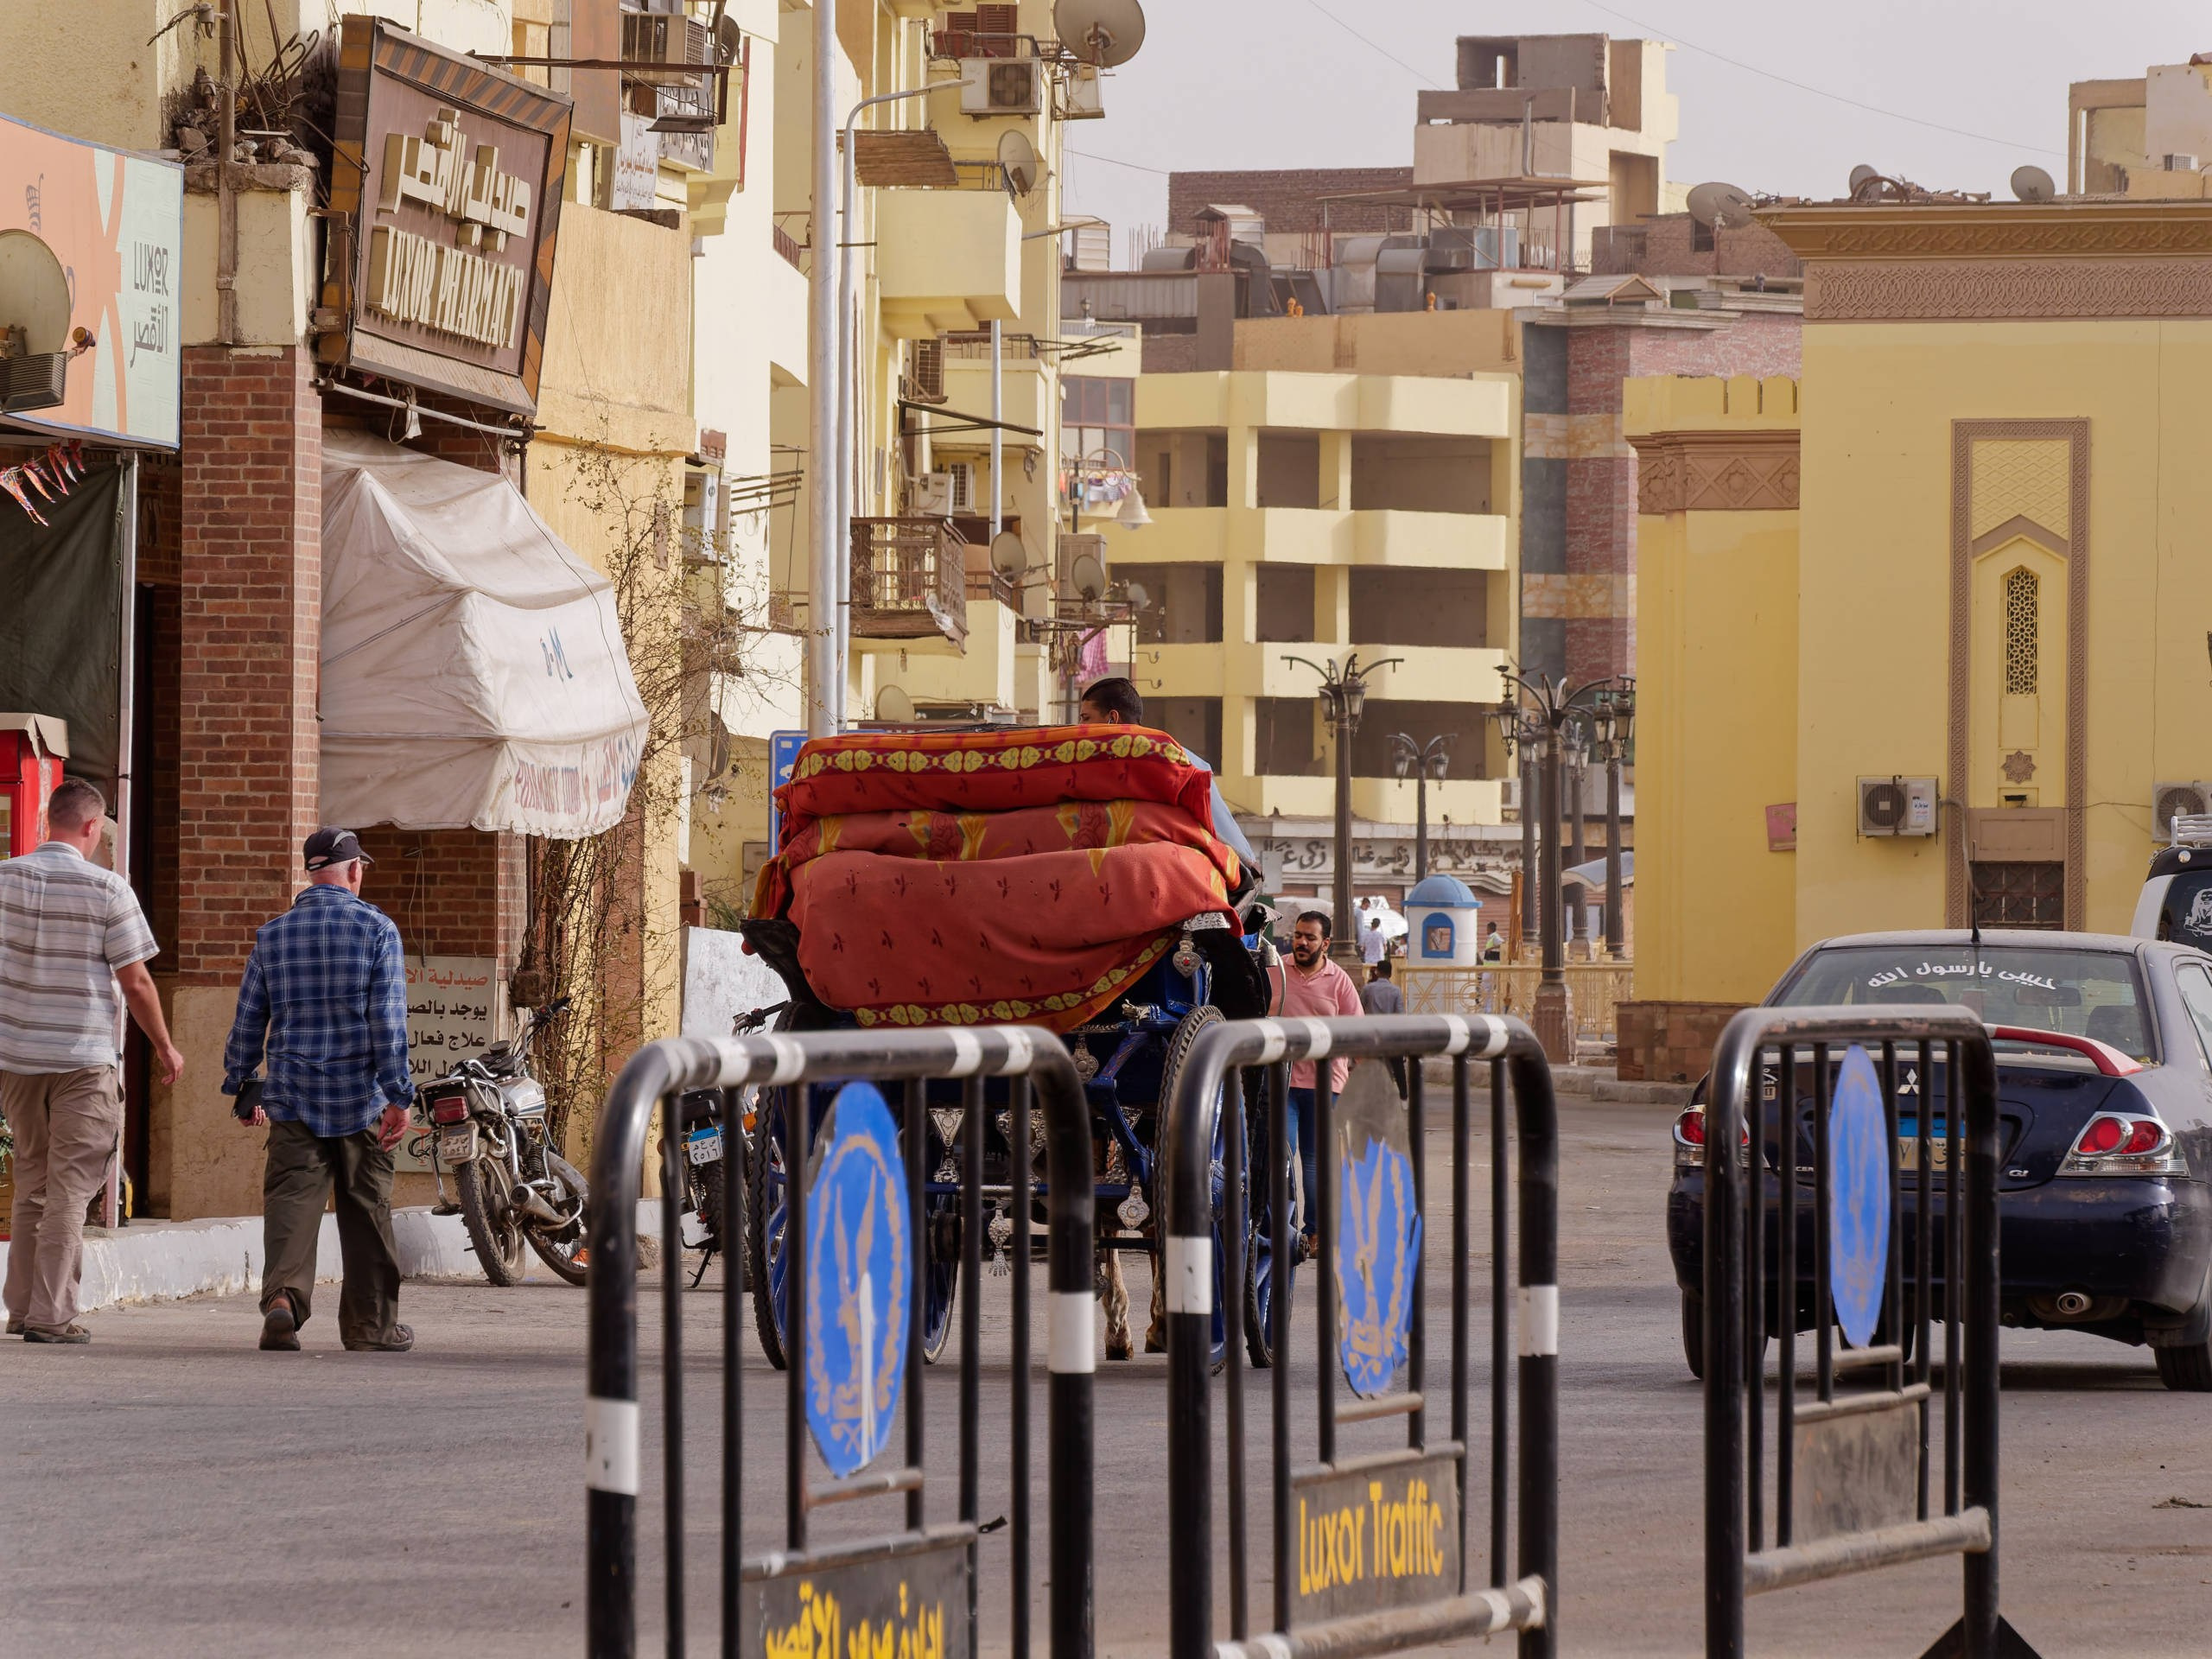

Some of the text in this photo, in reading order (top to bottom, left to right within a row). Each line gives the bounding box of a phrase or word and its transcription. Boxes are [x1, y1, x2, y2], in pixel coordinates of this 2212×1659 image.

[134, 240, 169, 297] LUXOR
[381, 225, 525, 350] LUXOR PHARMACY
[428, 968, 489, 990] صيدلية
[449, 1002, 488, 1021] يوجد
[408, 1030, 486, 1051] علاج فعال
[1300, 1478, 1444, 1596] Luxor Traffic
